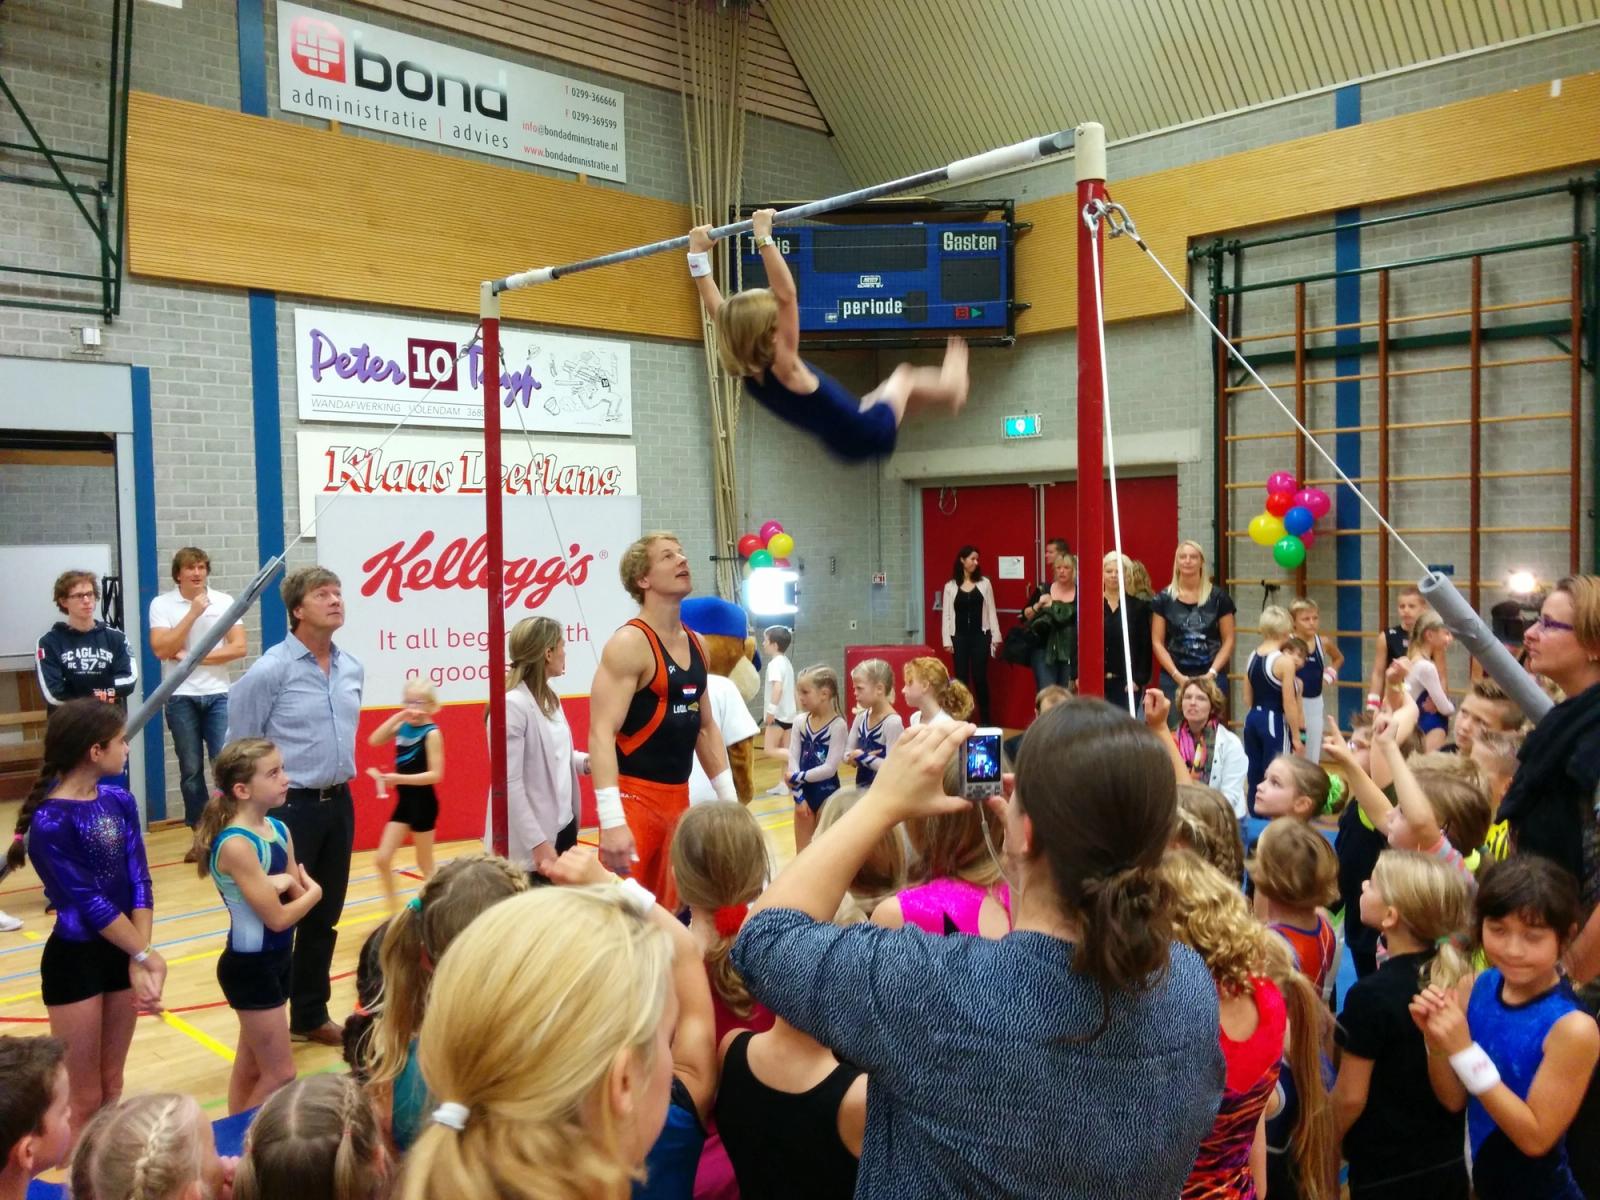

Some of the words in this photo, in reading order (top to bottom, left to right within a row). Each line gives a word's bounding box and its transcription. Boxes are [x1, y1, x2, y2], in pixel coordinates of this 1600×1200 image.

[353, 30, 509, 122] bond
[292, 88, 428, 132] administratie
[453, 123, 510, 150] advies
[522, 121, 618, 152] info@bondadministratie.nl
[523, 145, 619, 174] www.bondadministratie.nl
[748, 235, 790, 255] Tis
[943, 231, 998, 252] Gasten
[843, 297, 903, 319] periode
[309, 328, 407, 384] Peter
[412, 347, 454, 383] 10
[409, 403, 461, 417] VOLENDAM
[323, 445, 454, 494] Klaas
[379, 629, 398, 650] It
[406, 627, 439, 650] all
[81, 658, 98, 671] 57
